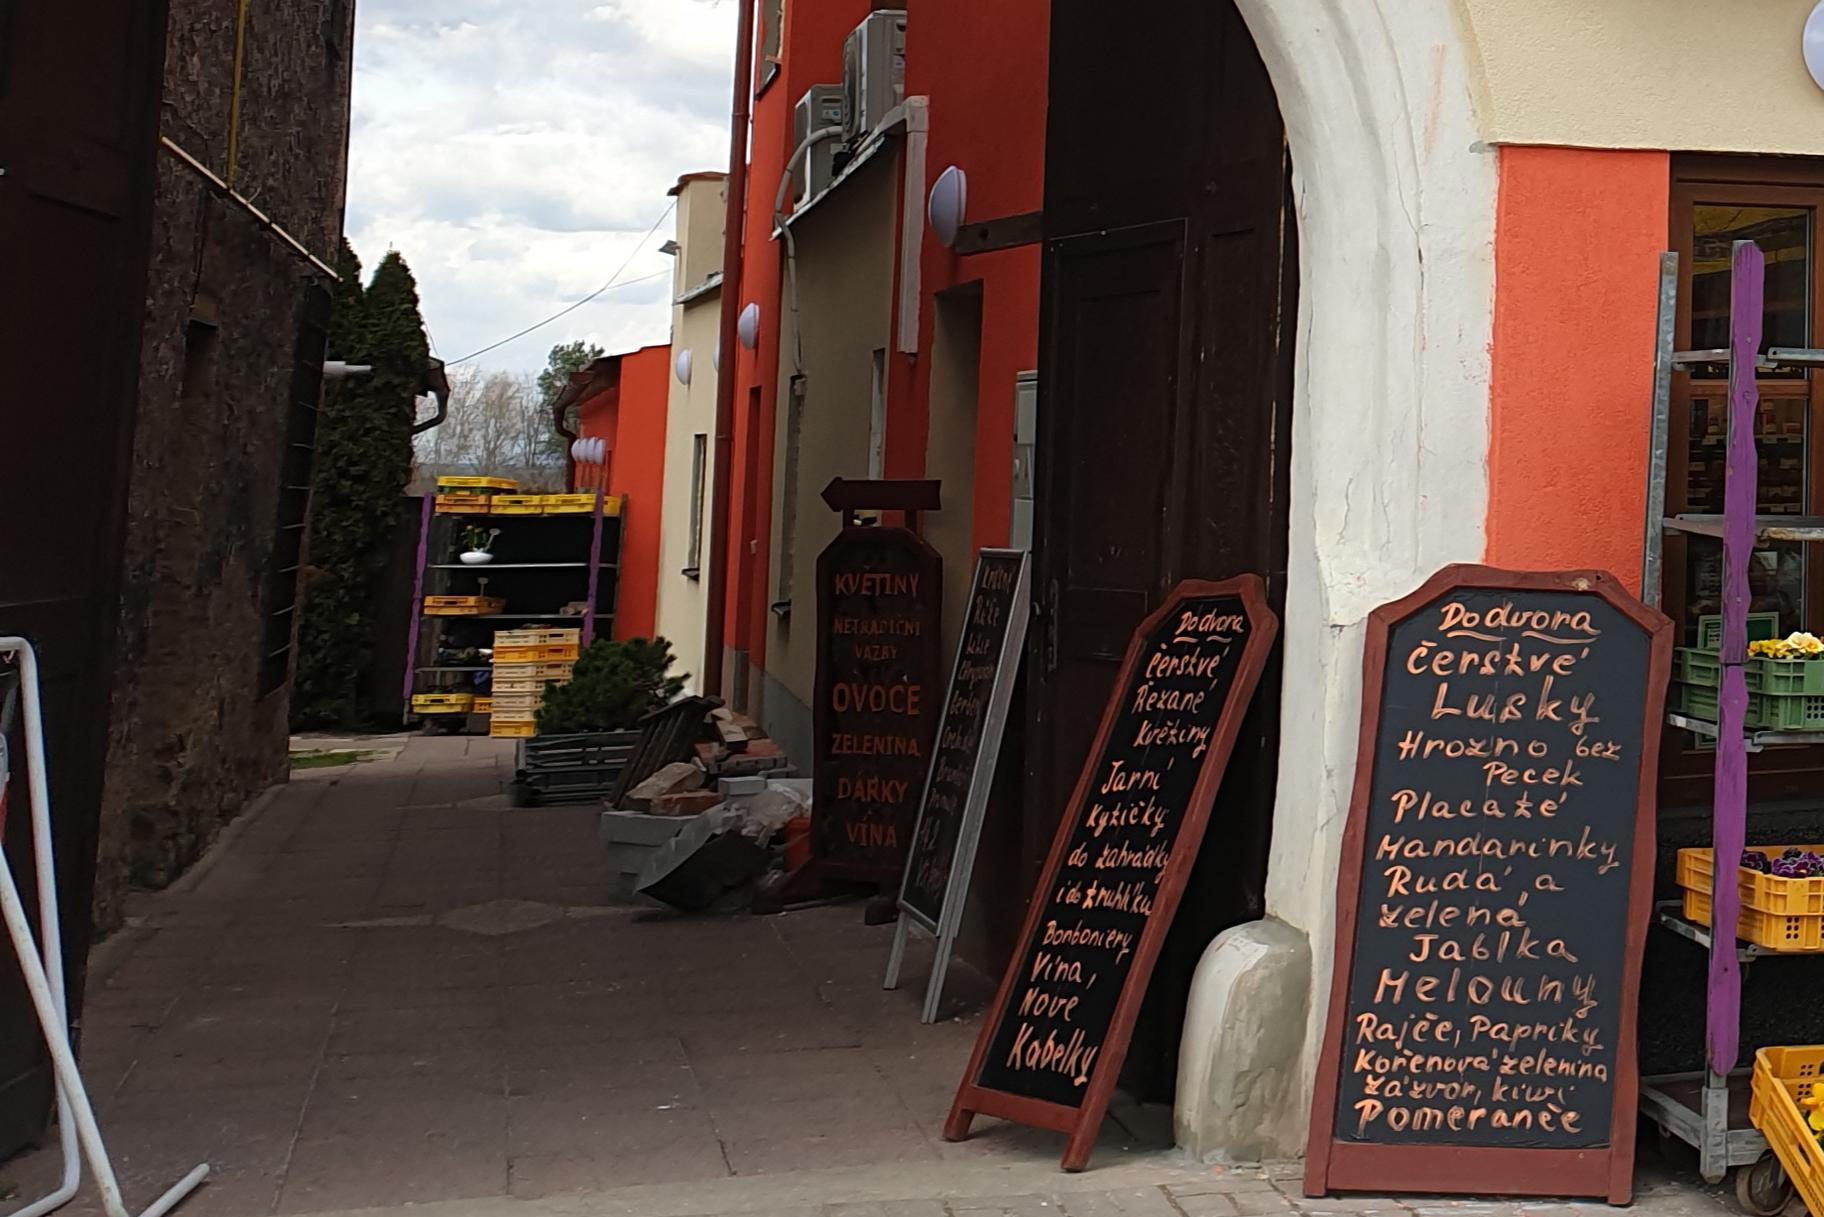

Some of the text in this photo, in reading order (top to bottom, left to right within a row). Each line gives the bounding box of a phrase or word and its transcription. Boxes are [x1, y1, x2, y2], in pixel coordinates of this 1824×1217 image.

[832, 681, 921, 716] OVOCE
[1431, 675, 1601, 736] Lusky
[832, 733, 920, 757] ZELENINA
[1397, 730, 1622, 761] Hrozno bez
[1101, 756, 1174, 794] Jarní
[1483, 759, 1584, 786] Pecek
[1391, 789, 1568, 824] Placaté
[1067, 841, 1089, 868] do
[1375, 825, 1620, 875] Mandarinky
[1383, 865, 1566, 898] Rudá a
[1409, 927, 1579, 963] Jablka
[1373, 967, 1599, 1019] Melouny
[1469, 1014, 1604, 1056] Papriky
[1006, 1022, 1098, 1086] Kabelky
[1354, 1047, 1499, 1076] Kořenová
[1354, 1099, 1584, 1137] Pomeranče
